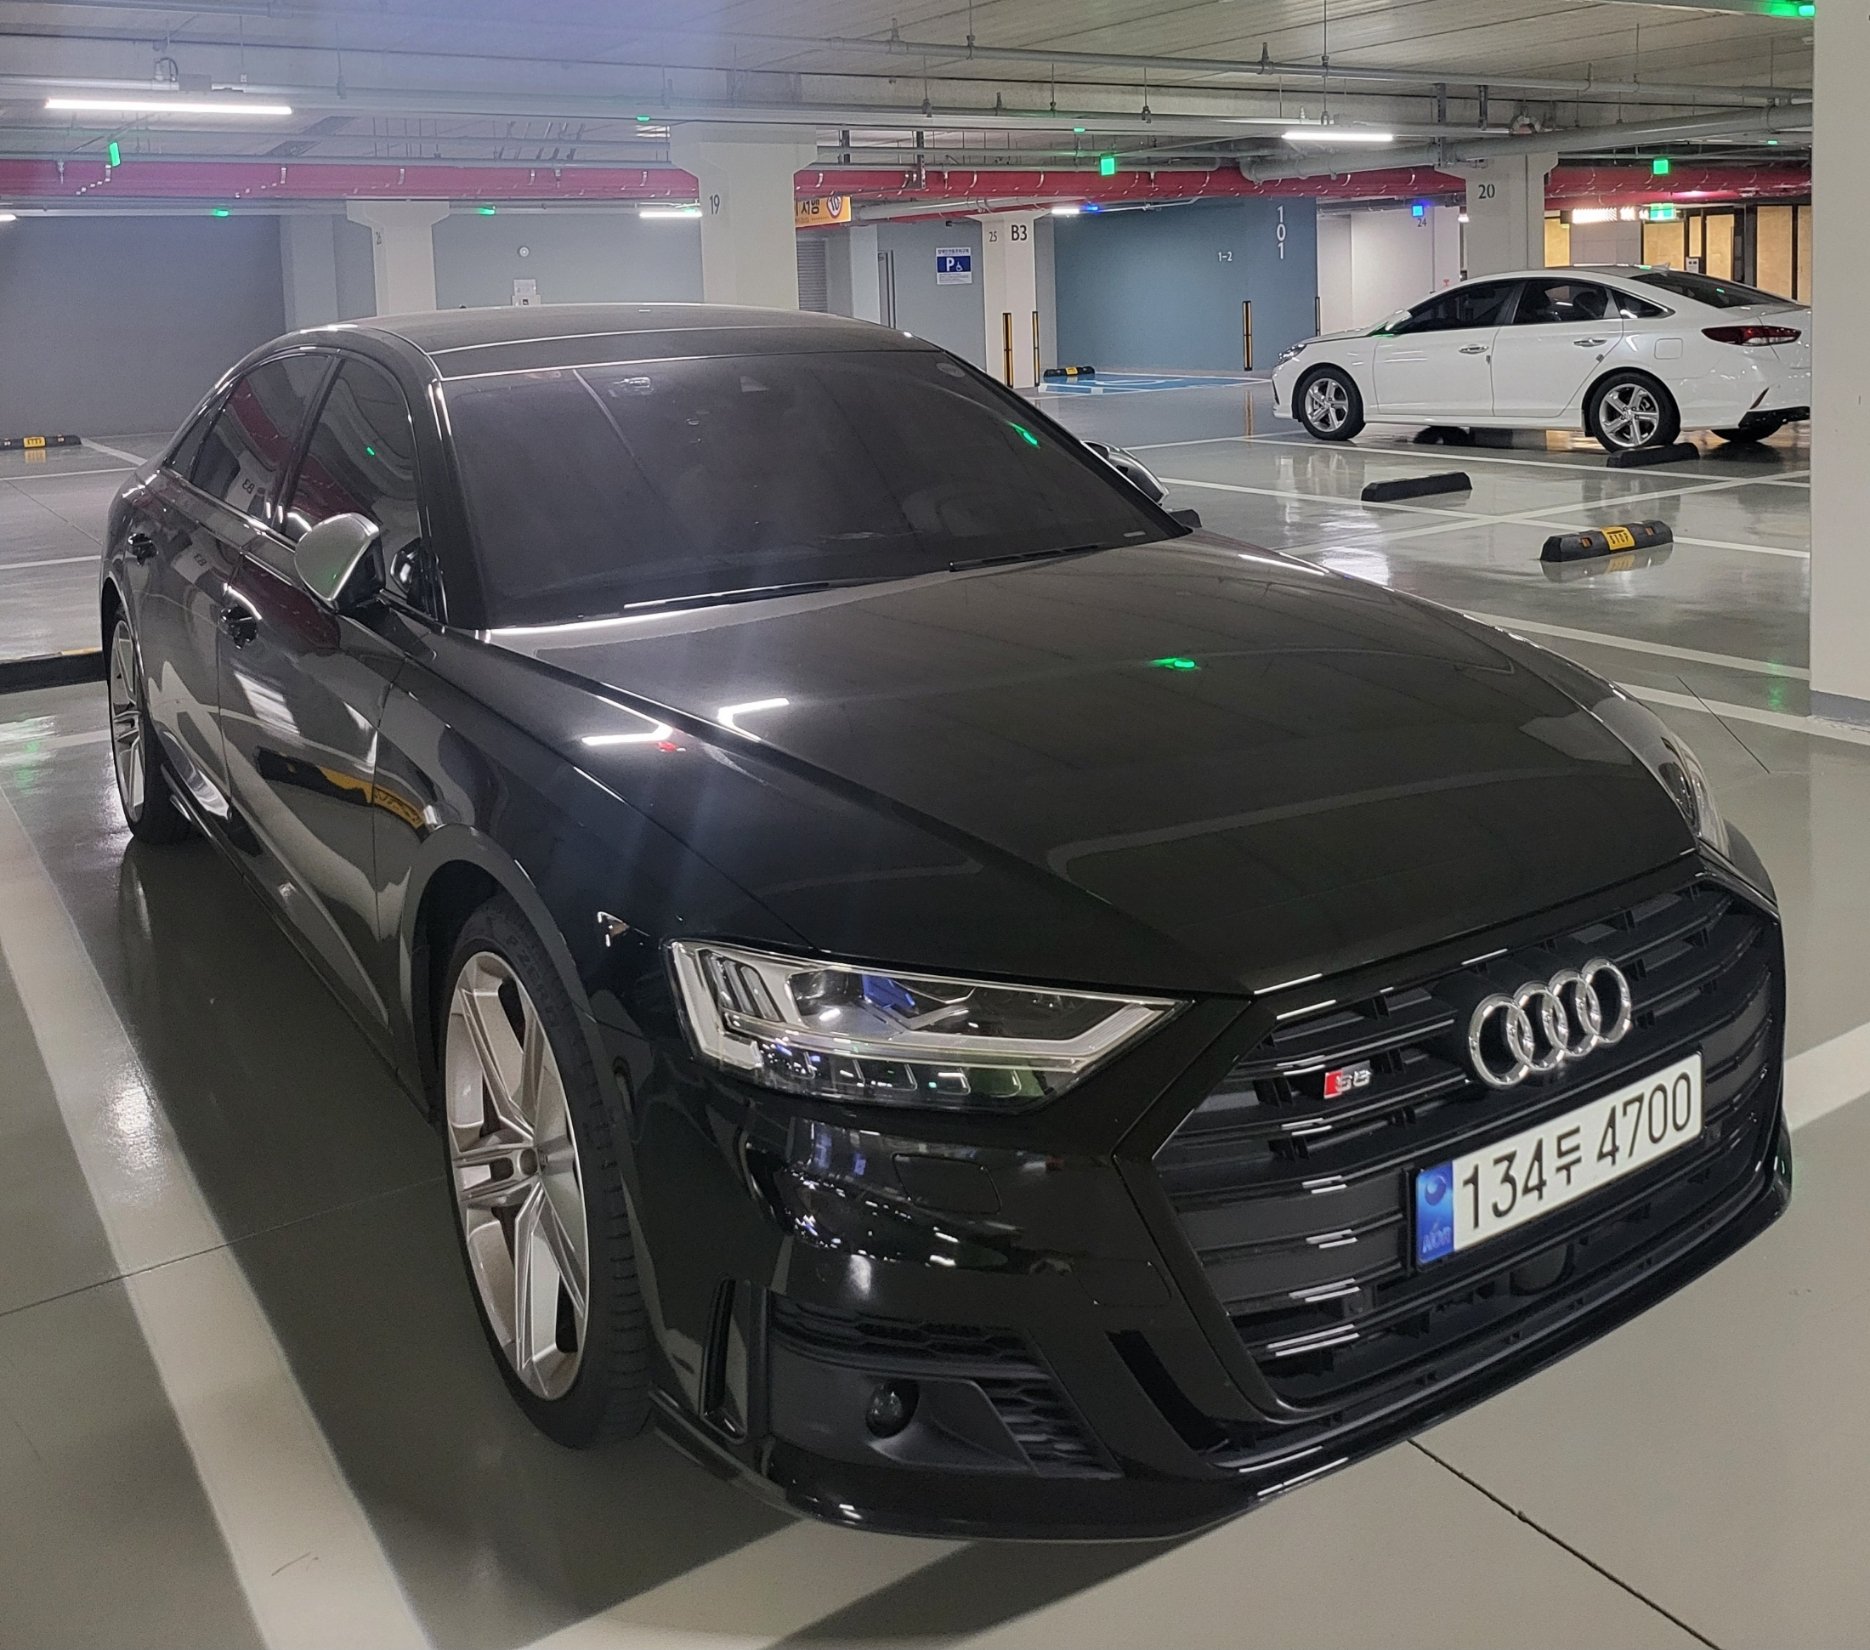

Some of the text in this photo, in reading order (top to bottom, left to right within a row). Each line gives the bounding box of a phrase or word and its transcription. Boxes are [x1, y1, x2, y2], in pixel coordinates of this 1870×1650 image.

[1478, 184, 1496, 199] 20
[709, 194, 720, 215] 19
[1417, 218, 1427, 228] 24
[988, 230, 998, 242] 25
[1011, 224, 1028, 241] B3
[1277, 205, 1286, 260] 101
[1218, 251, 1233, 262] 1-2
[946, 257, 955, 272] P
[1608, 531, 1631, 546] STOP
[1335, 1069, 1372, 1093] S8
[1462, 1071, 1692, 1230] 134두 4700
